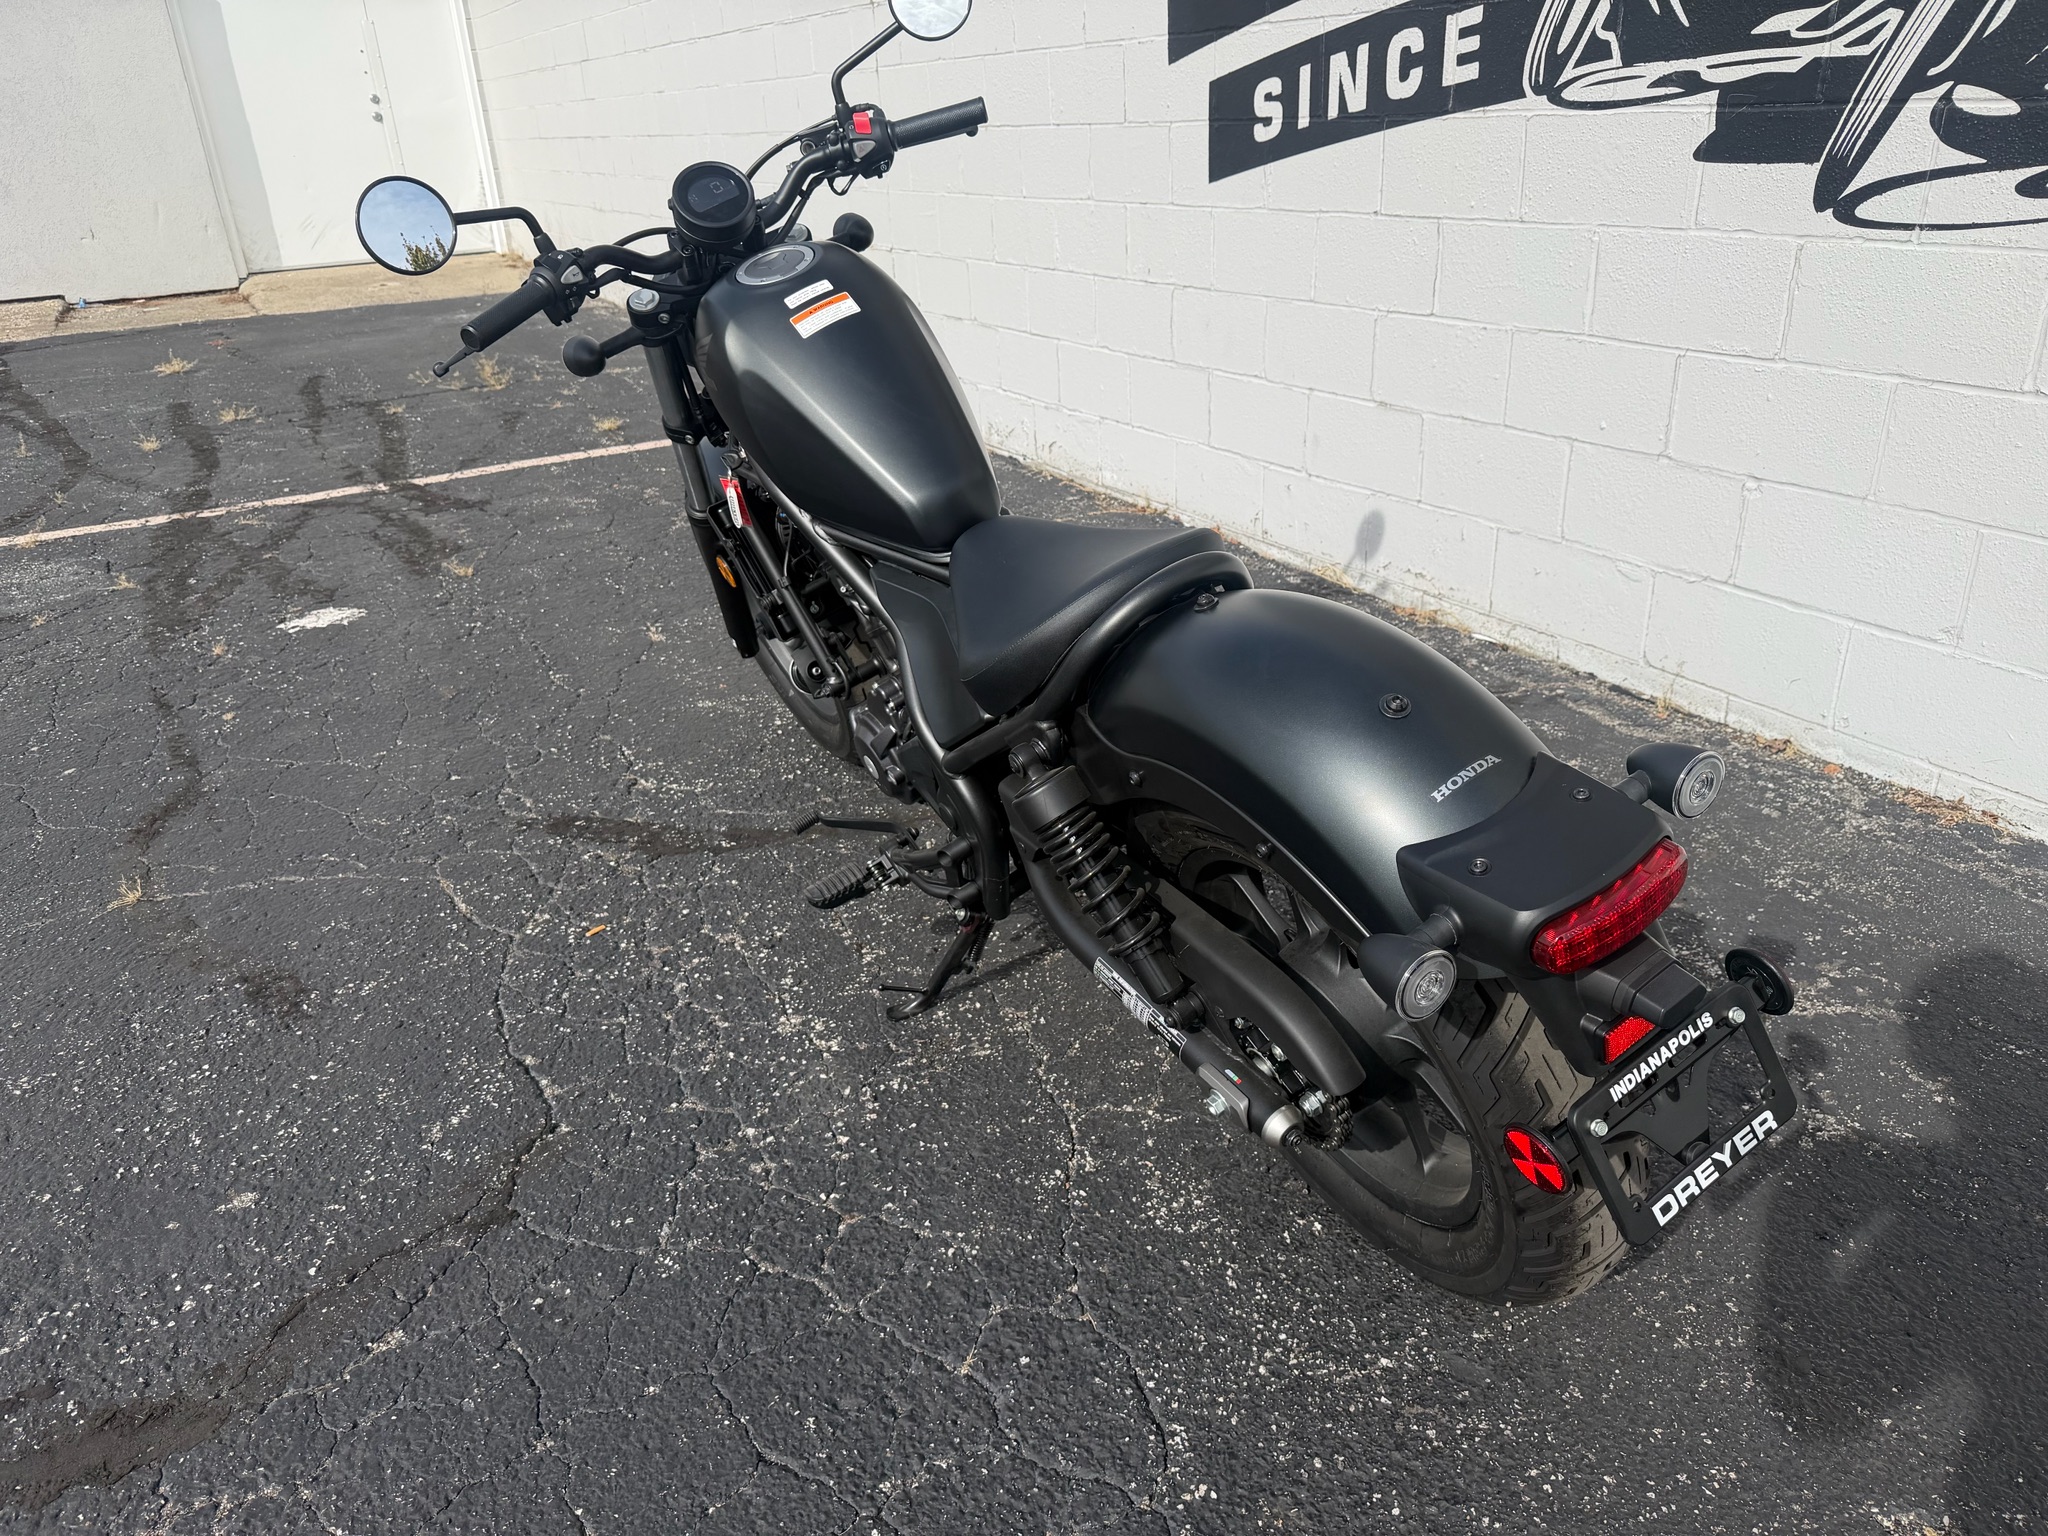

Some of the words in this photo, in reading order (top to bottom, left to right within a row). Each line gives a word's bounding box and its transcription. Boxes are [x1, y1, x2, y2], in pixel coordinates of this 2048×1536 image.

[1253, 4, 1484, 143] SINCE
[1430, 754, 1502, 803] HONDA
[1609, 1011, 1715, 1103] INDIANAPOLIS
[1651, 1109, 1779, 1227] DREYER
